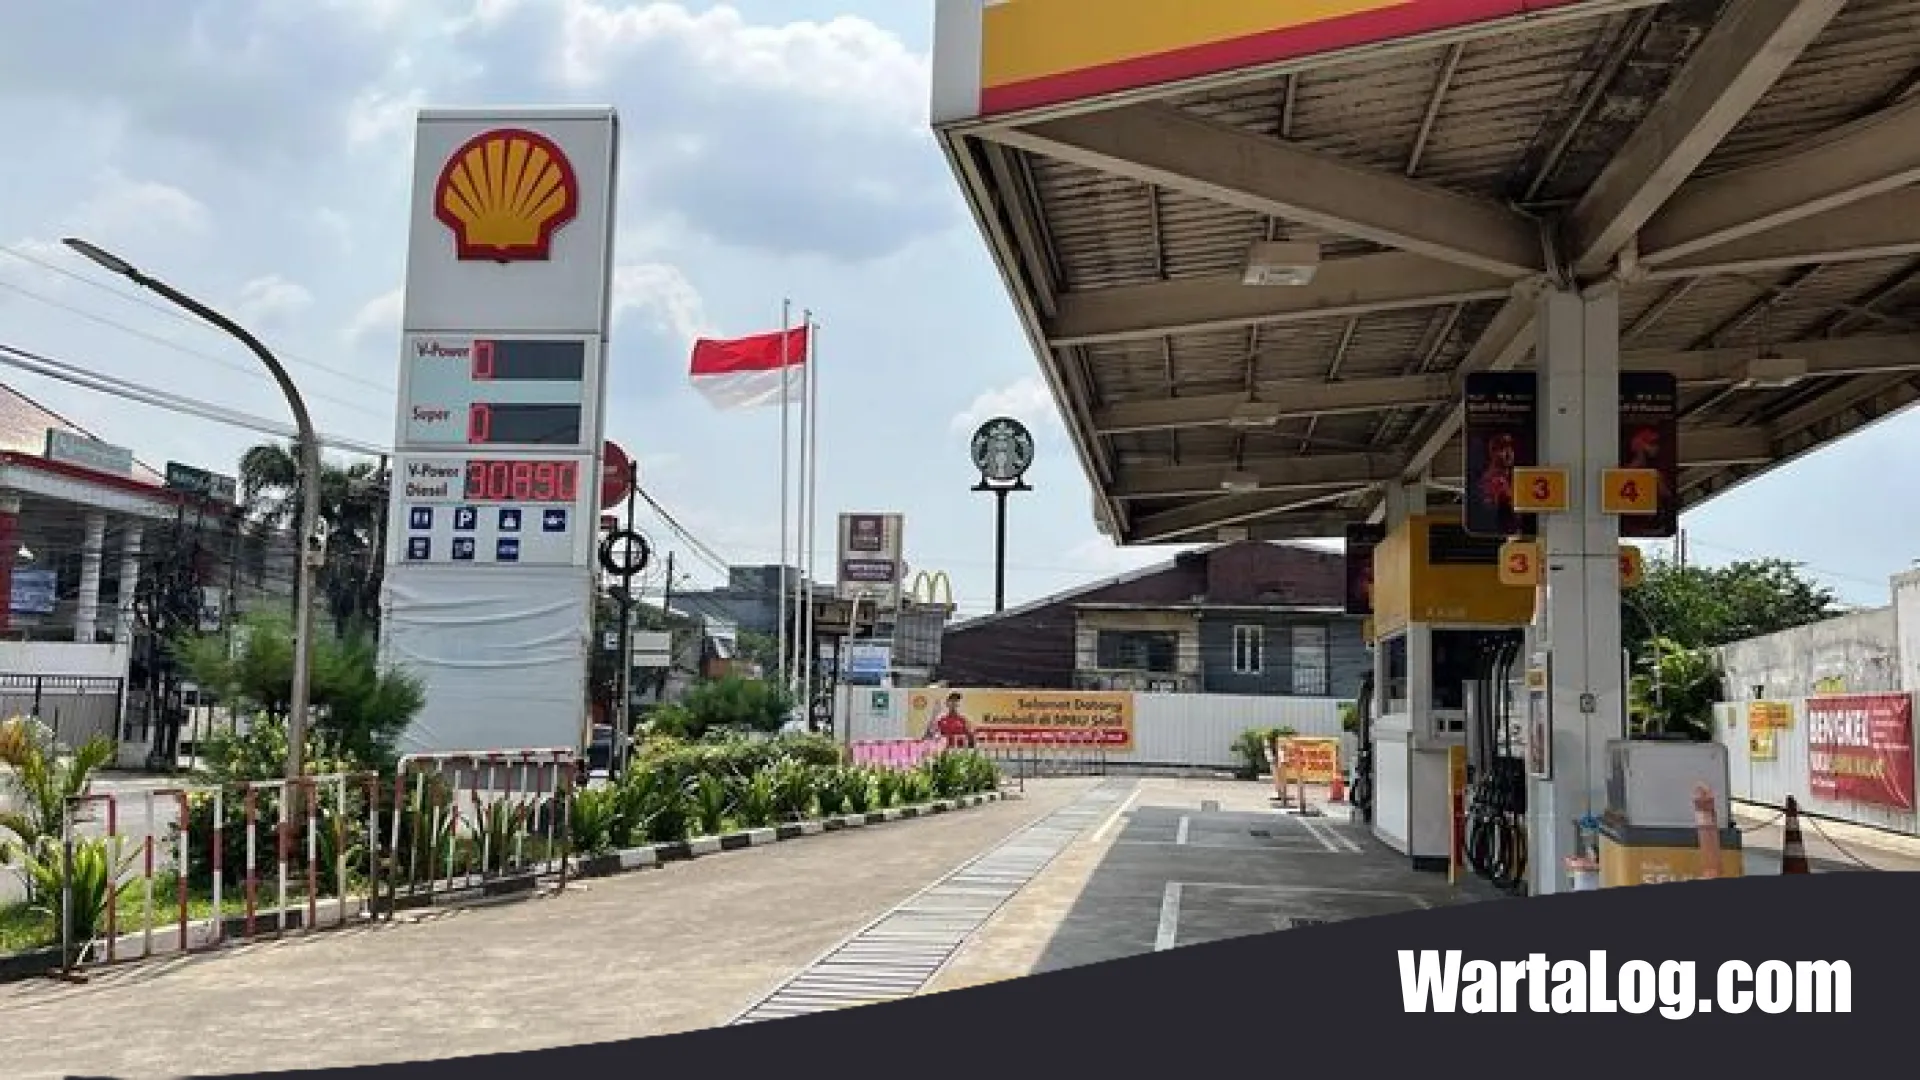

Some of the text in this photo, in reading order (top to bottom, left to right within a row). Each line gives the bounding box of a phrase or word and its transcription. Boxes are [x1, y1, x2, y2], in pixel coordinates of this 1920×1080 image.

[417, 342, 469, 357] V-Power
[413, 405, 450, 425] Super
[408, 463, 458, 477] V-Power
[405, 482, 448, 497] Diesel
[1532, 476, 1549, 500] 3
[1620, 480, 1640, 502] 4
[1508, 553, 1529, 574] 3
[1018, 698, 1123, 712] Selamat Datang
[982, 713, 1035, 725] Kembali
[1039, 713, 1051, 724] di
[1094, 714, 1122, 726] Shell
[1809, 709, 1869, 746] BENGKEL
